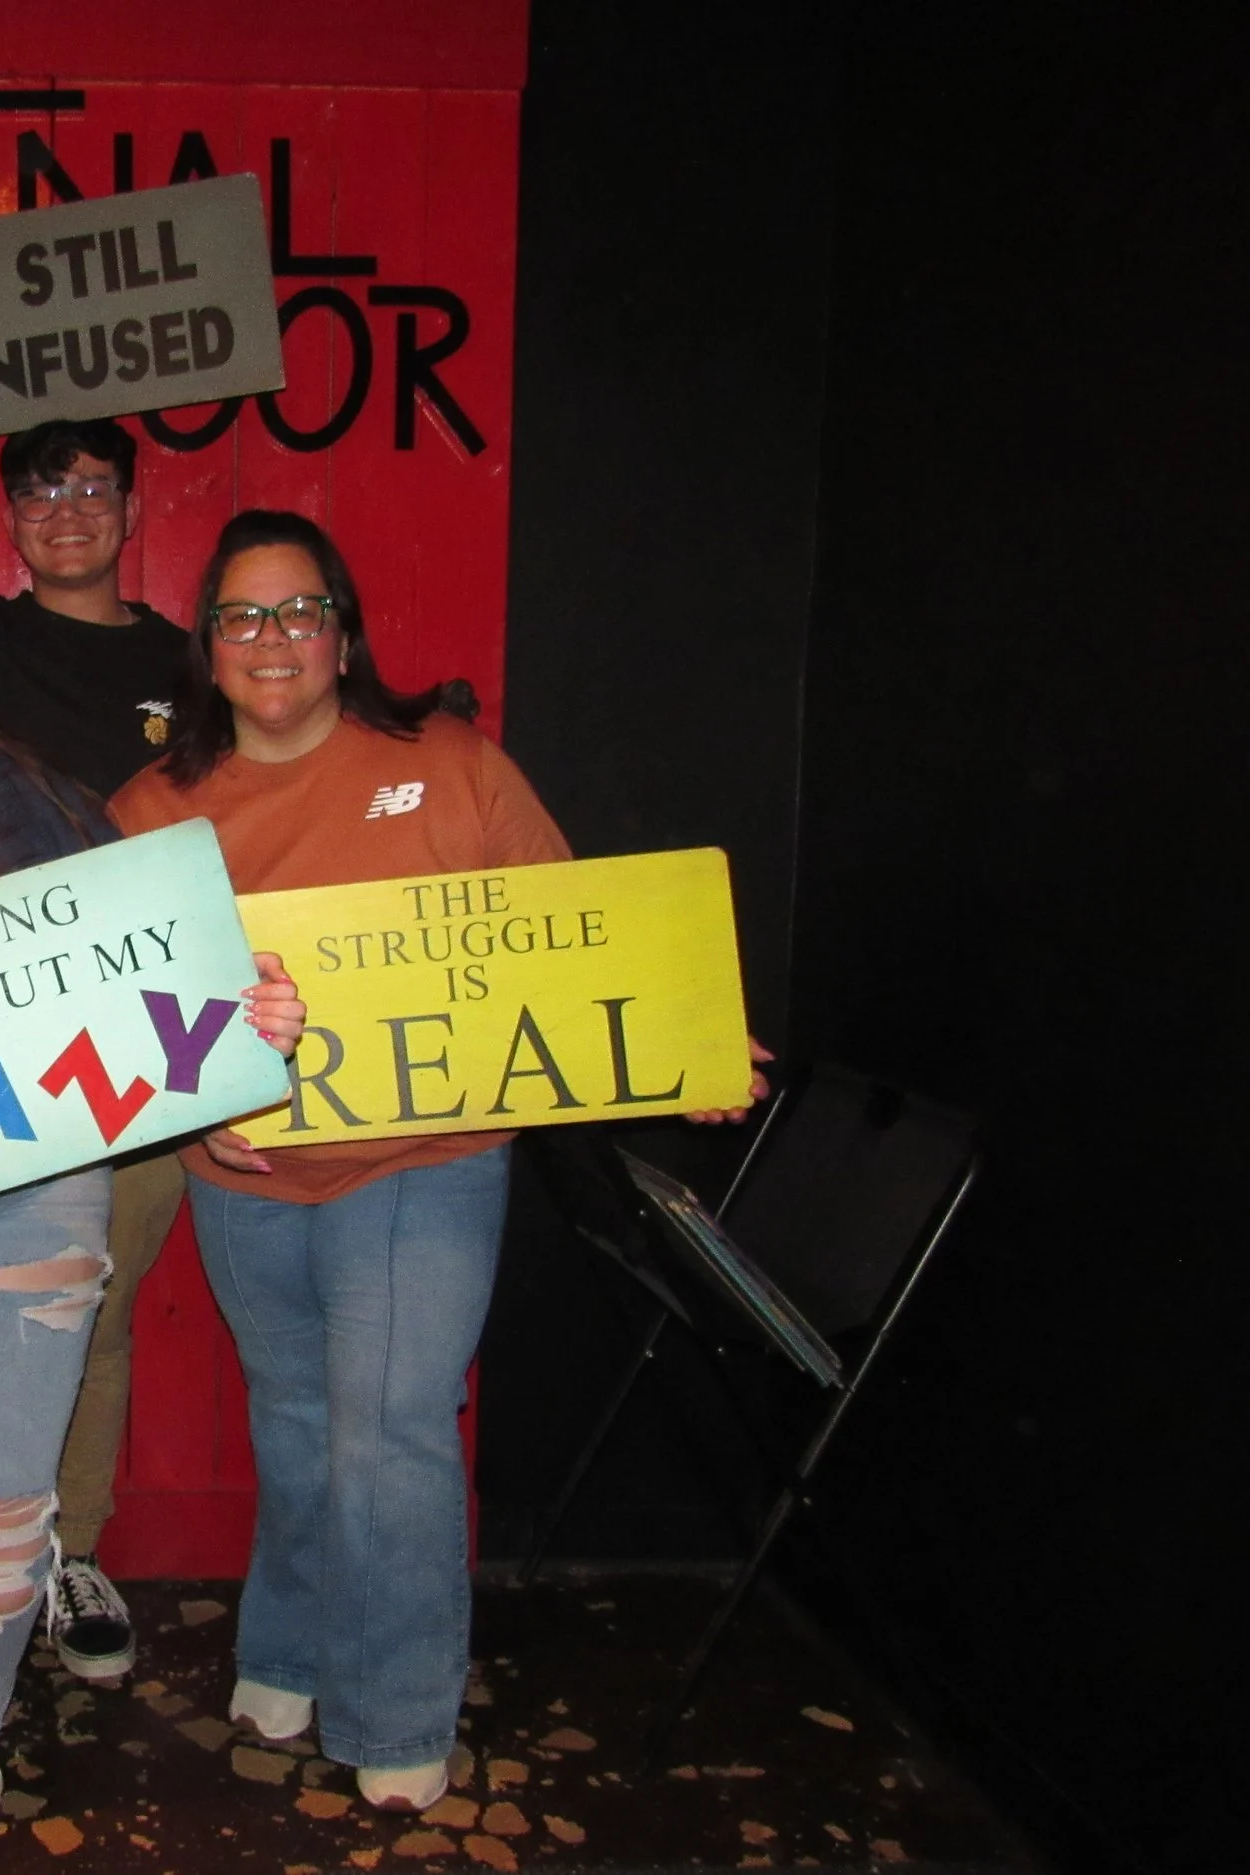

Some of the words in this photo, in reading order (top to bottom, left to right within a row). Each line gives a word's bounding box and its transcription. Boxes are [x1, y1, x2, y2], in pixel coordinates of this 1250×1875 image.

[16, 220, 198, 307] STILL
[403, 877, 510, 921] THE
[90, 920, 179, 982] MY
[316, 910, 609, 972] STRUGGLE
[445, 963, 489, 1002] IS
[278, 996, 686, 1133] REAL
